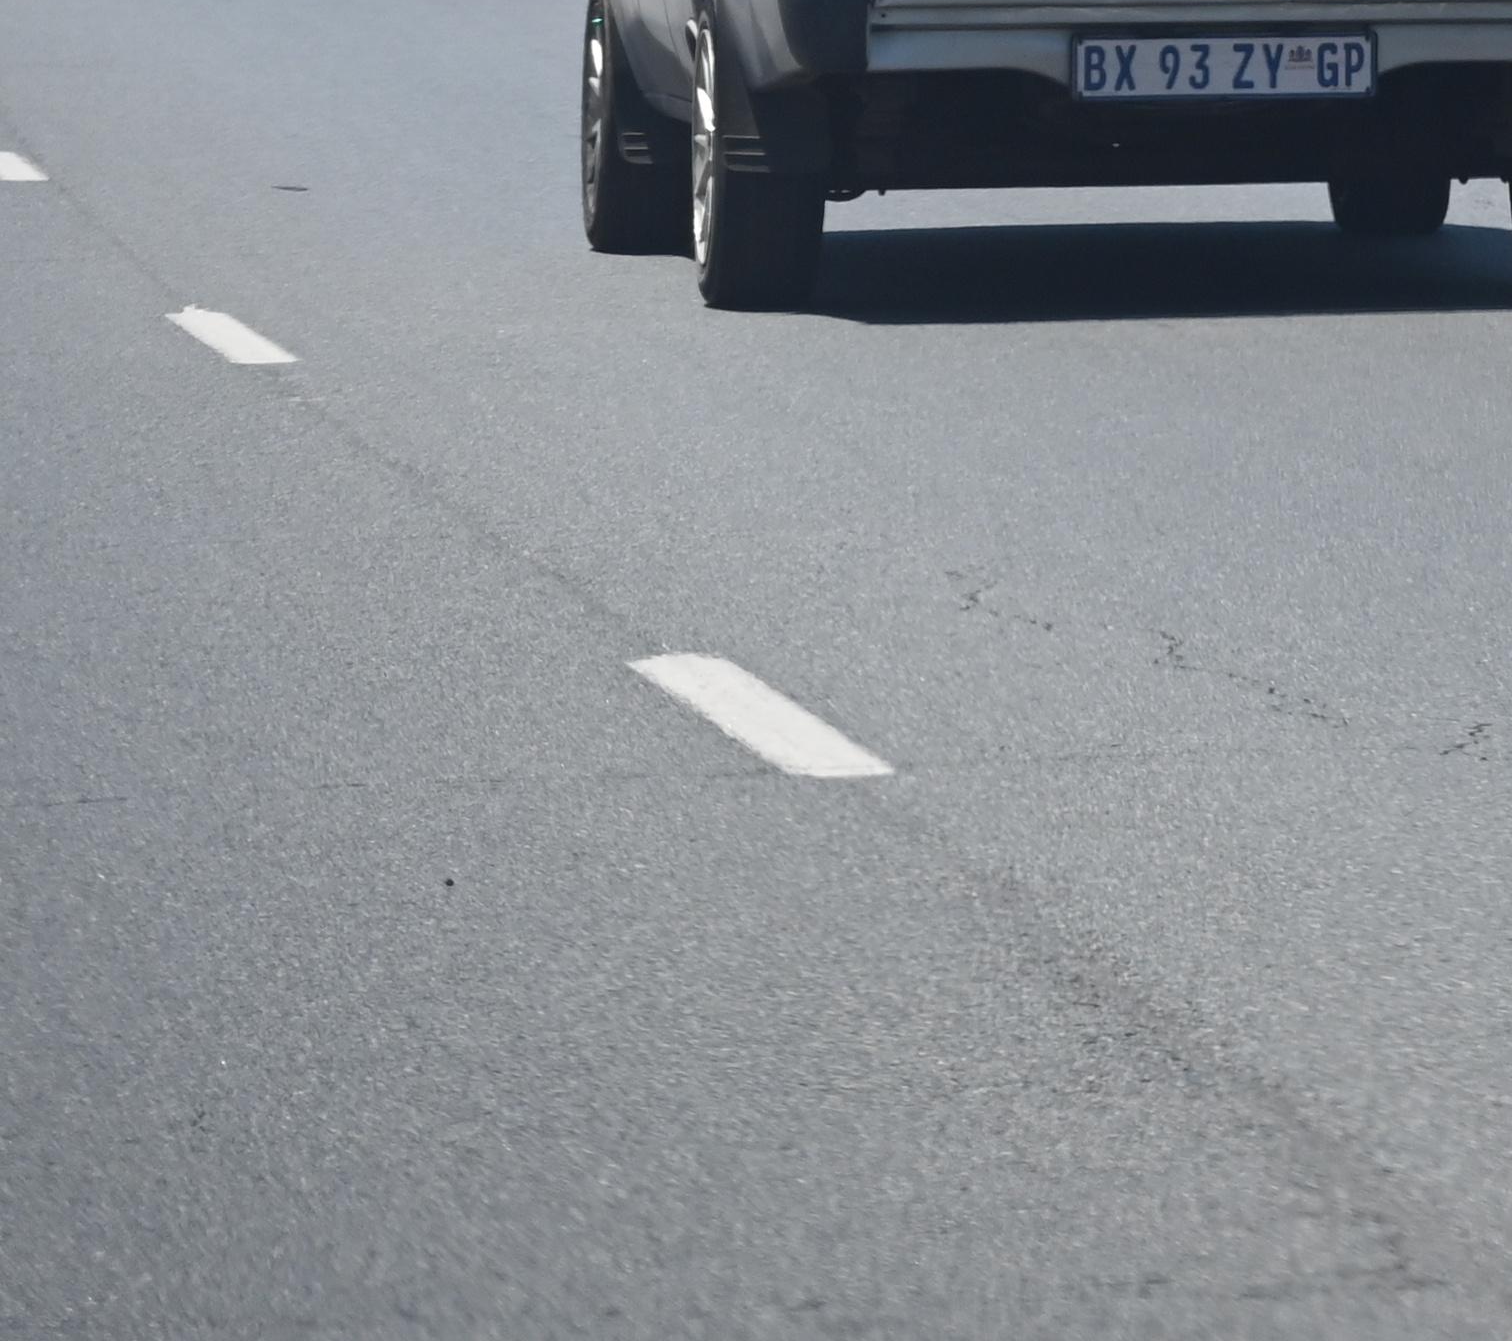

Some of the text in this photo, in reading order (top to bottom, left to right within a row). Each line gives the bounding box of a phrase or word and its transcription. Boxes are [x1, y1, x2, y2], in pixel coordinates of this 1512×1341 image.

[1083, 42, 1365, 91] BX 93 ZY GP
